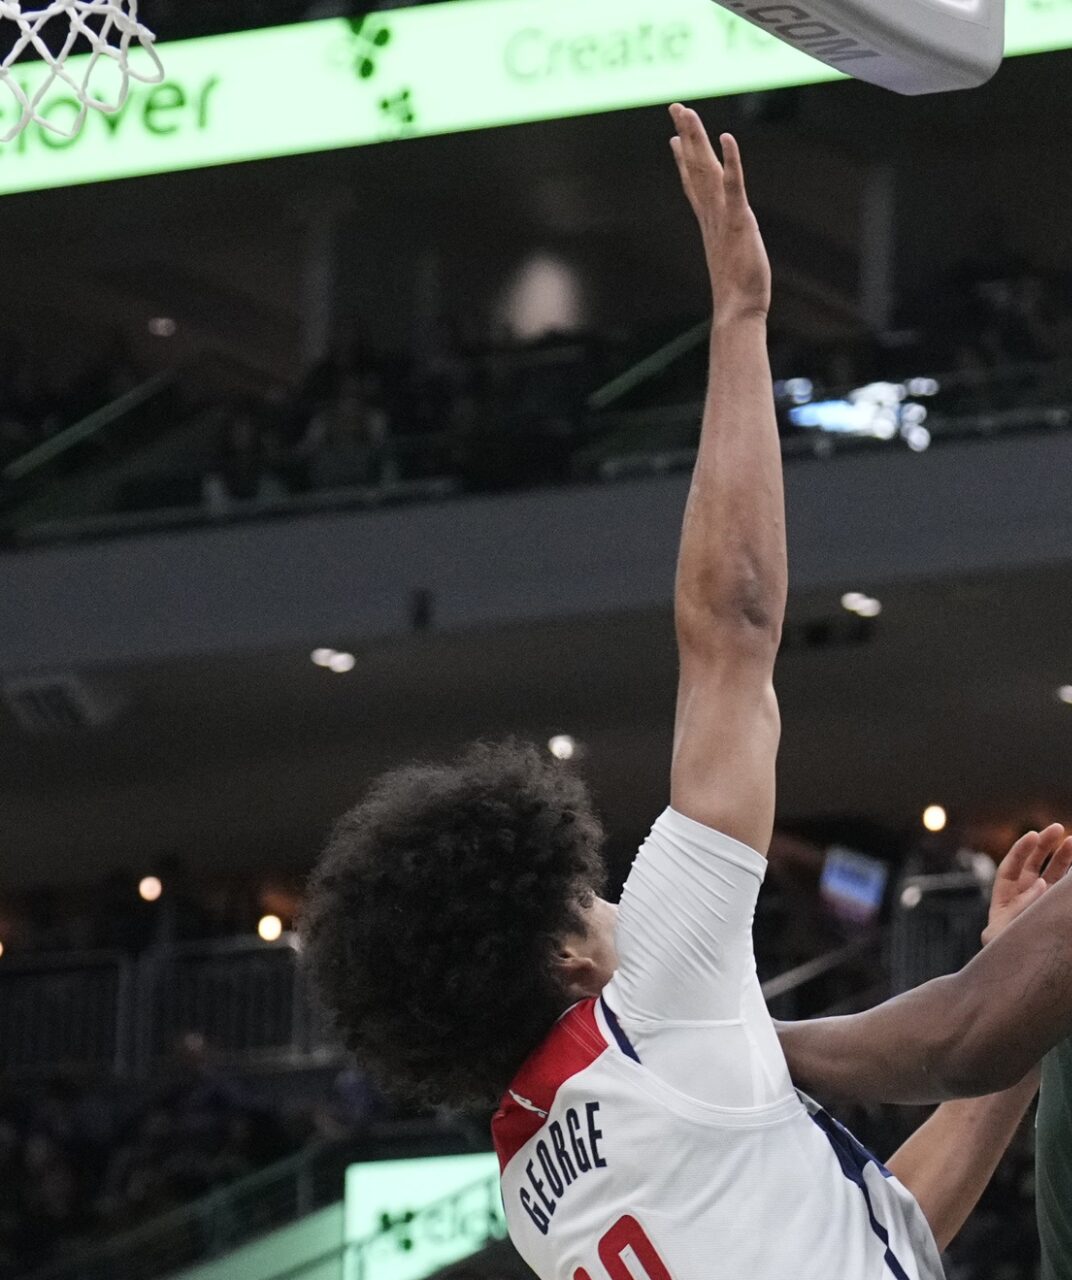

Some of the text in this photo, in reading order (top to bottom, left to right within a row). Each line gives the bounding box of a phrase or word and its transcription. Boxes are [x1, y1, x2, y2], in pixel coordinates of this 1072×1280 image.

[503, 20, 692, 80] Create
[0, 73, 220, 155] lover
[518, 1100, 608, 1236] GEORGE
